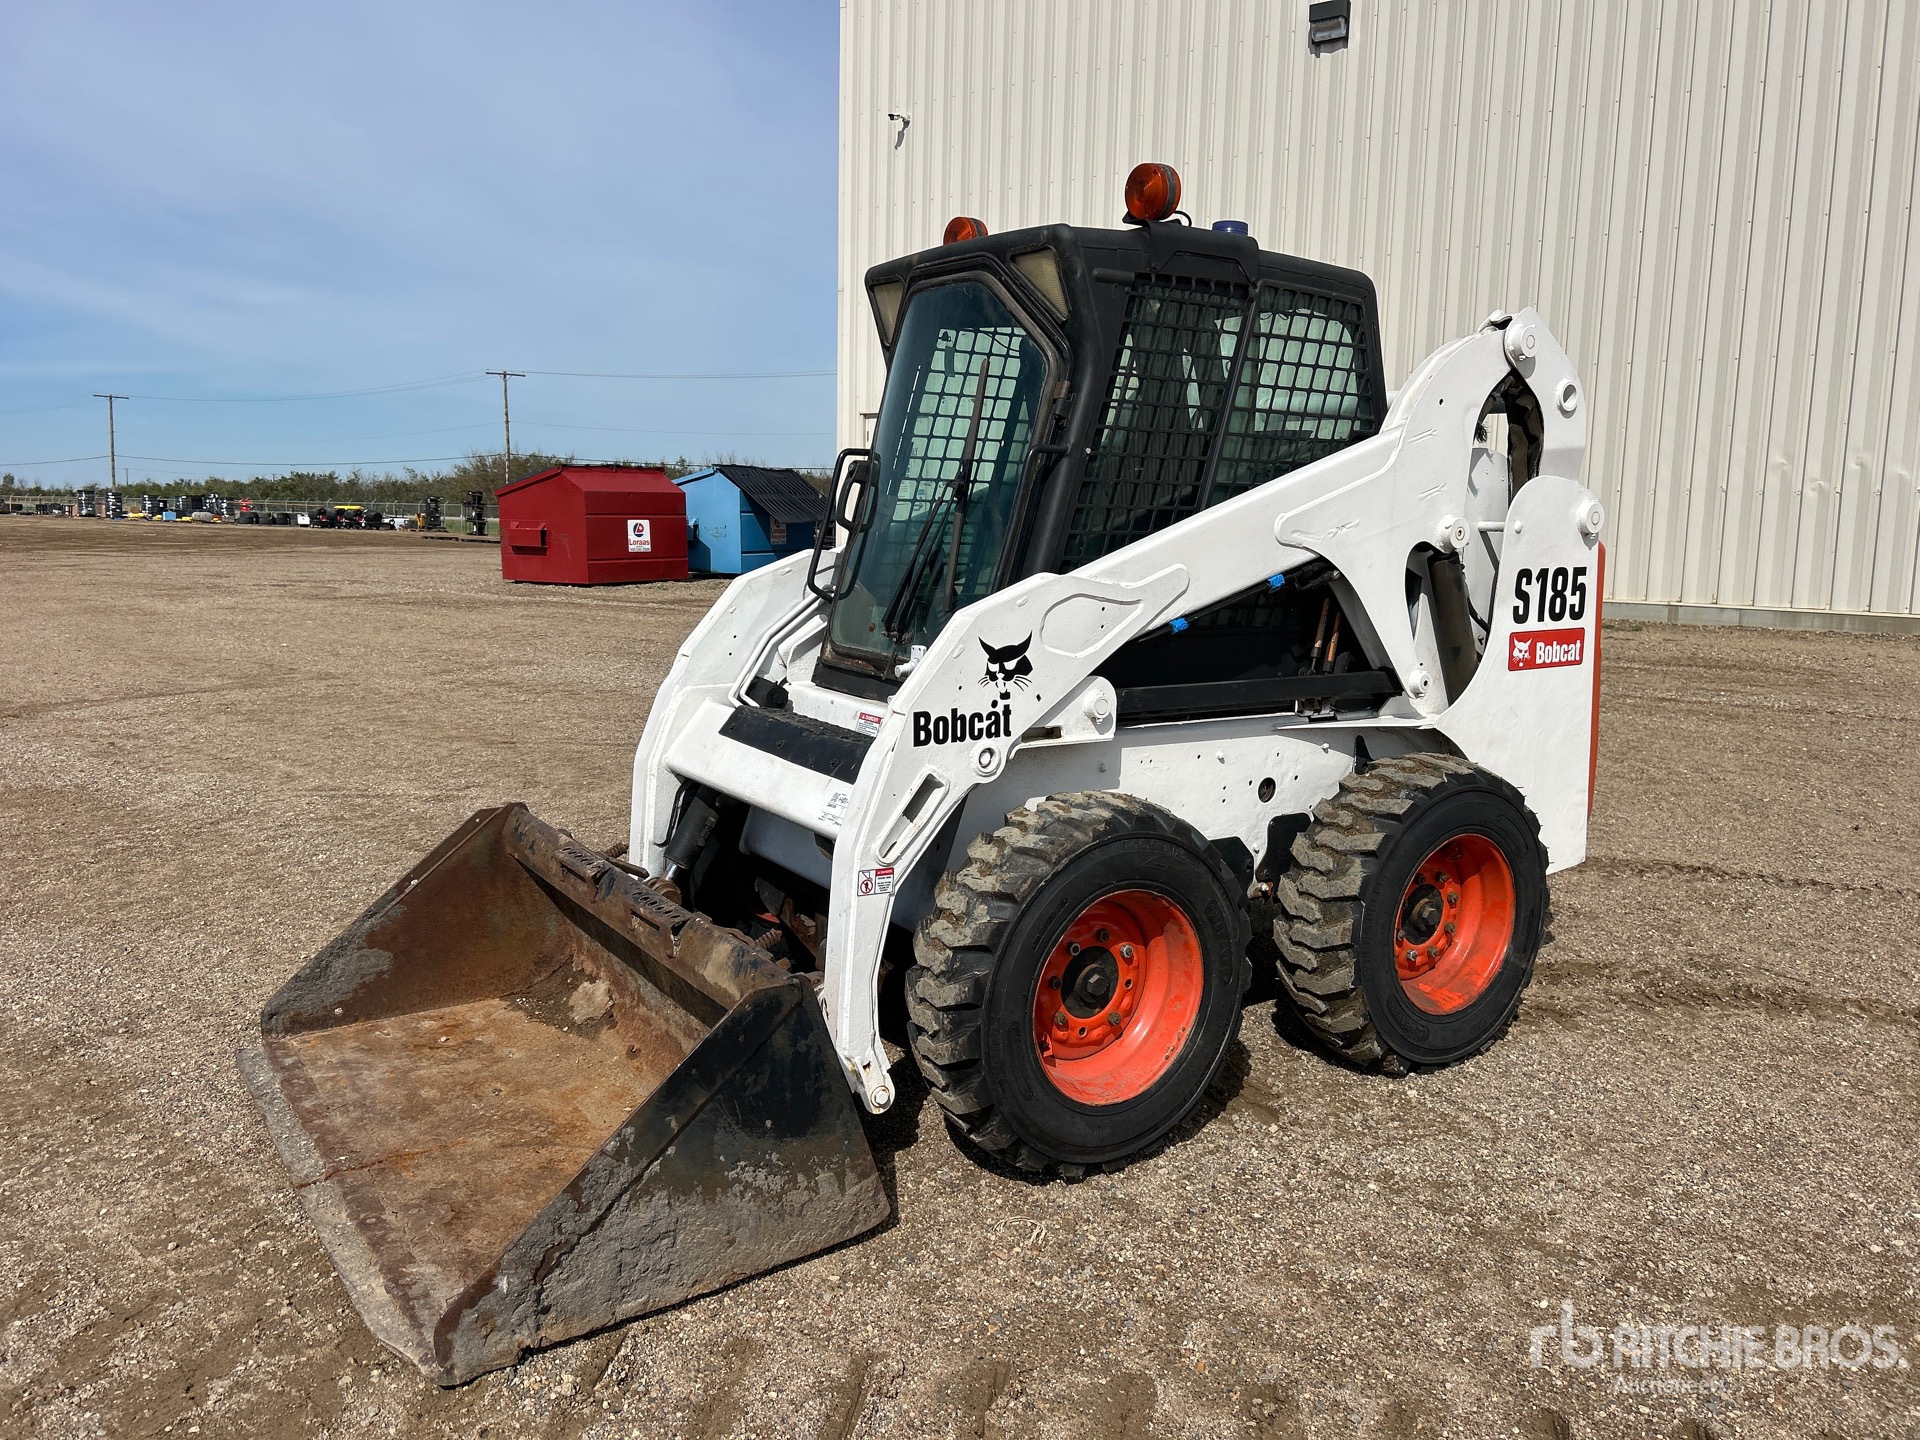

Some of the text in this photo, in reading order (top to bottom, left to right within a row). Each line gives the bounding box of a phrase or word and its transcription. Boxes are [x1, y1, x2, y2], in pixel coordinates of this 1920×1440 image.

[1513, 566, 1587, 625] S185
[1535, 640, 1581, 665] Bobcat
[913, 704, 1011, 747] Bobcat
